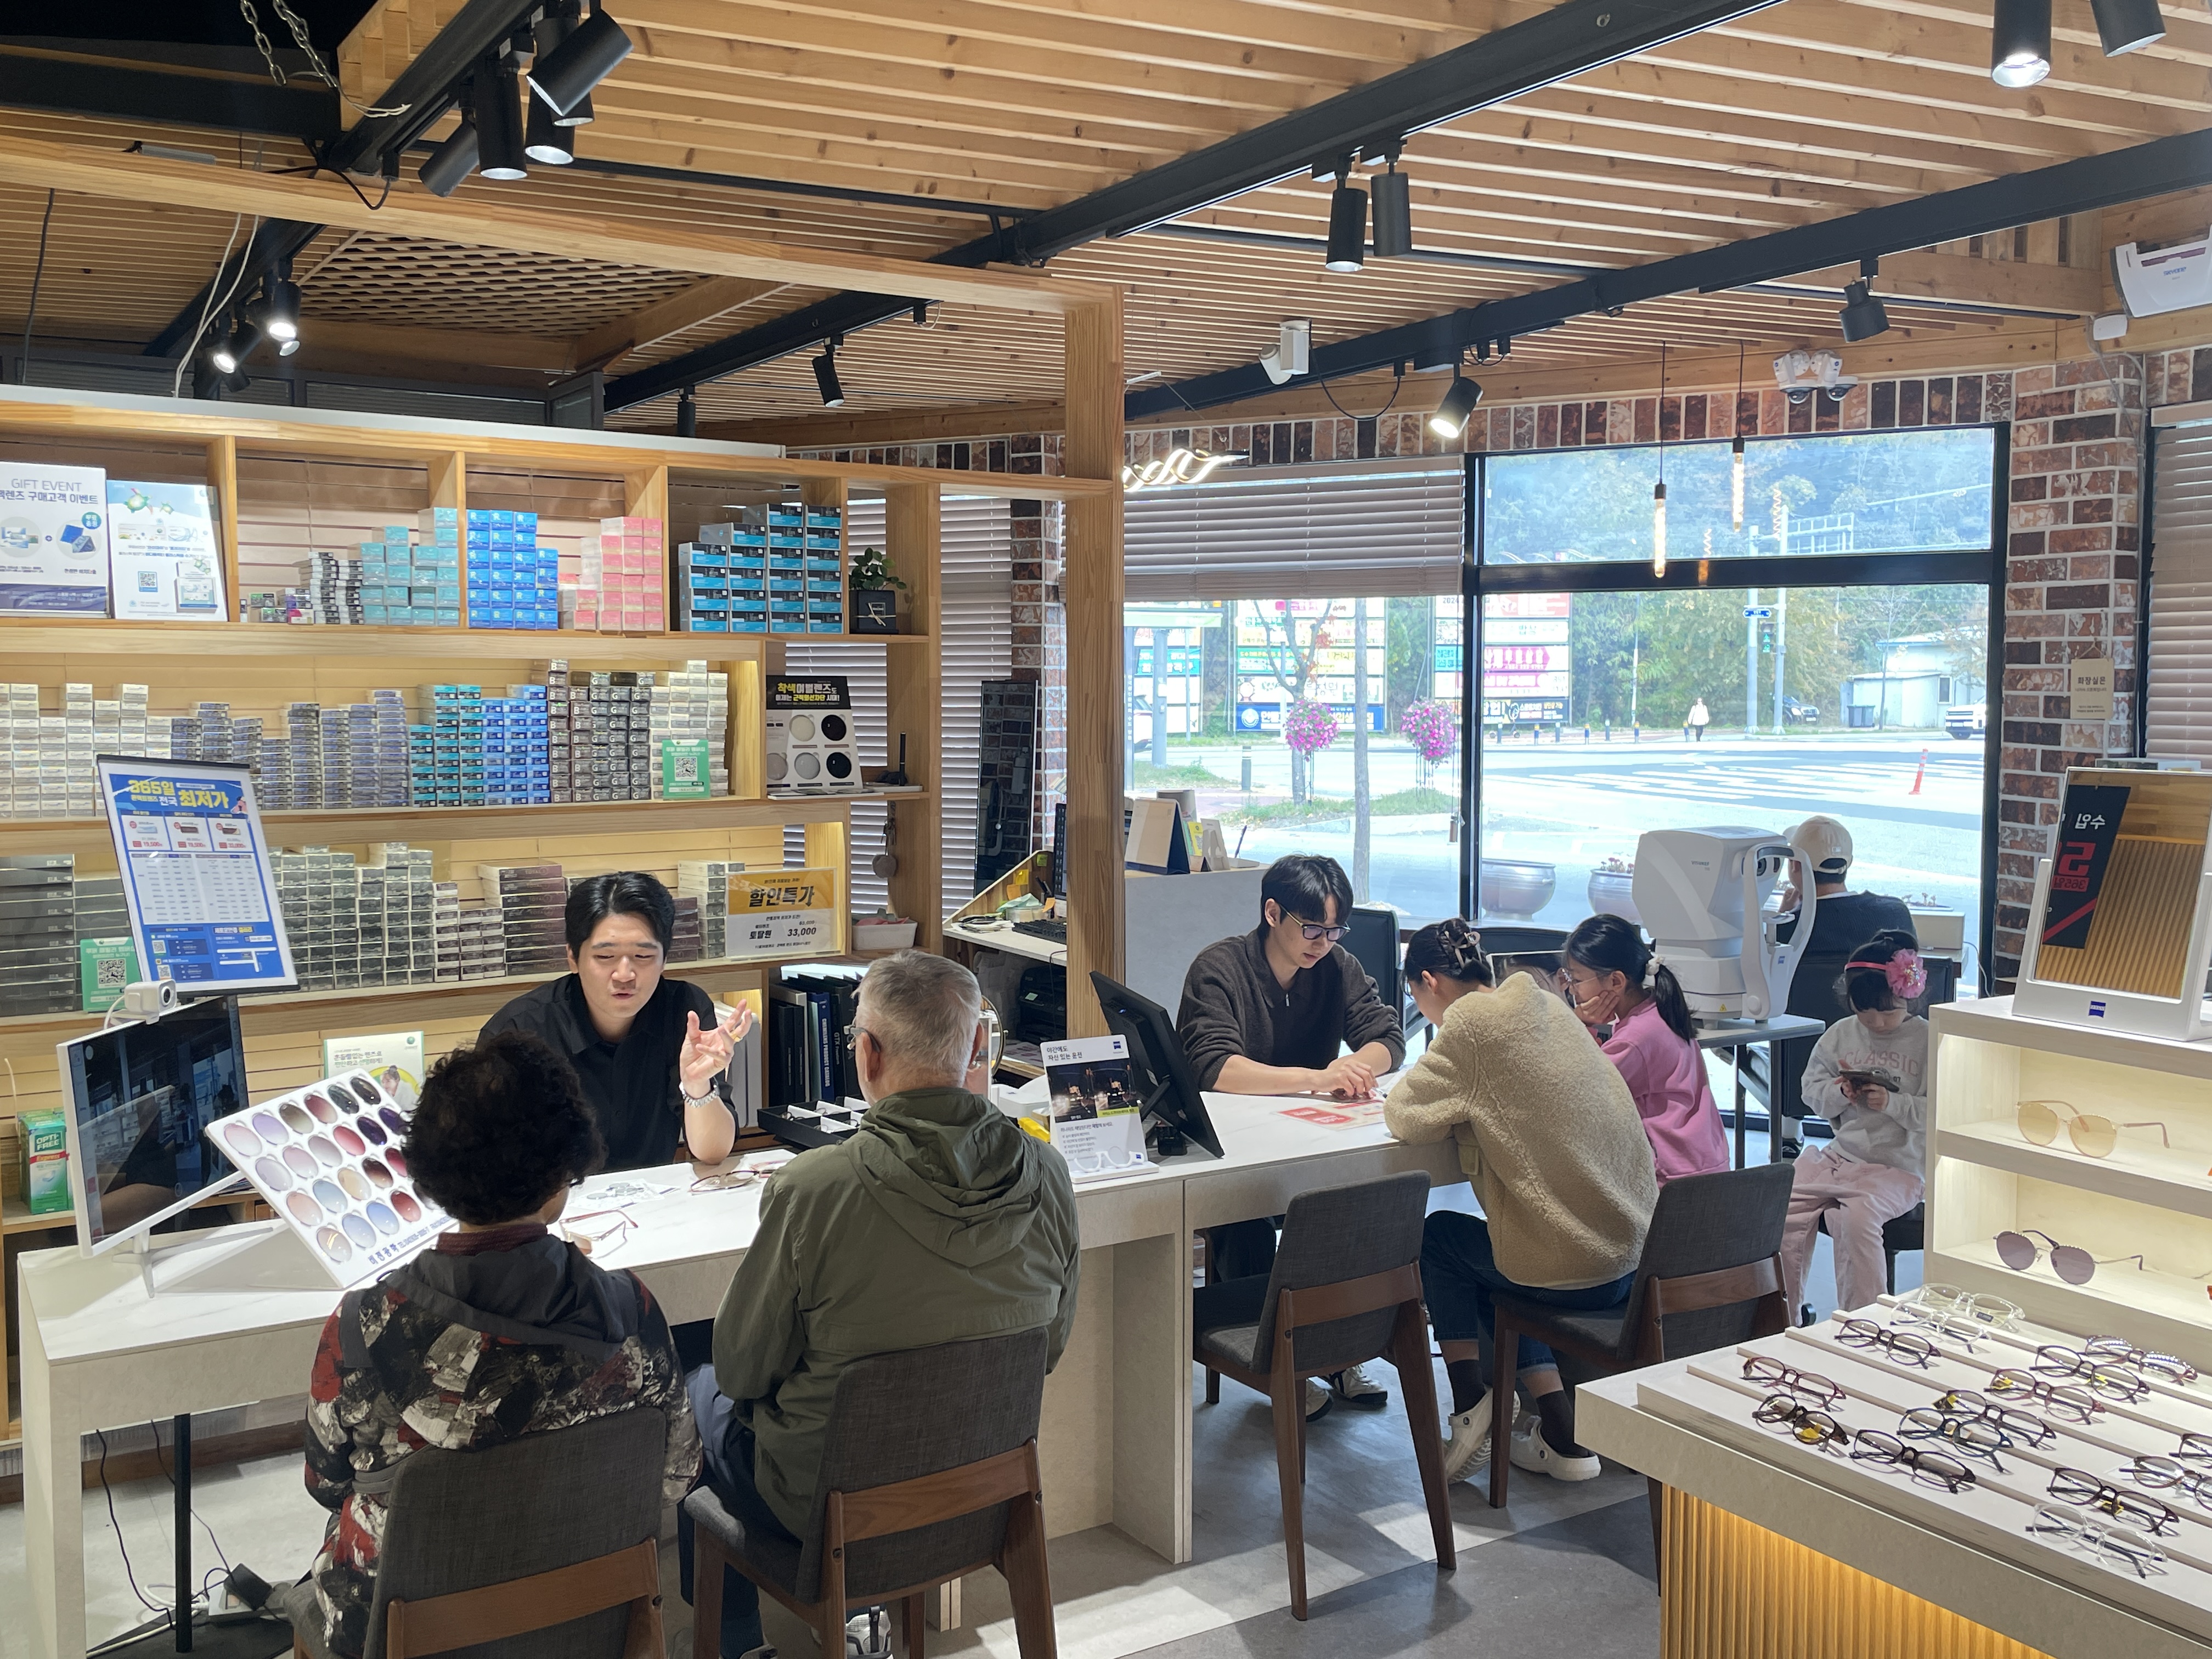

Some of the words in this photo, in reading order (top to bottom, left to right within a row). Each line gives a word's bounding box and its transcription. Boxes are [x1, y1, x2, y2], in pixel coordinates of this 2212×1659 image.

[11, 478, 38, 489] GIFT
[42, 481, 82, 492] EVENT
[28, 492, 67, 503] 구매고객
[70, 494, 99, 505] 이벤트
[551, 662, 557, 670] B
[2078, 676, 2106, 685] 화장실은
[575, 721, 581, 729] B
[128, 780, 176, 795] 365일
[159, 796, 178, 806] 전국
[178, 789, 229, 809] 최저가
[749, 885, 815, 907] 할인특가
[787, 927, 816, 937] 33,000
[1846, 1049, 1918, 1076] CLASSIC
[36, 1133, 59, 1144] OPTI-
[37, 1139, 59, 1151] FREE
